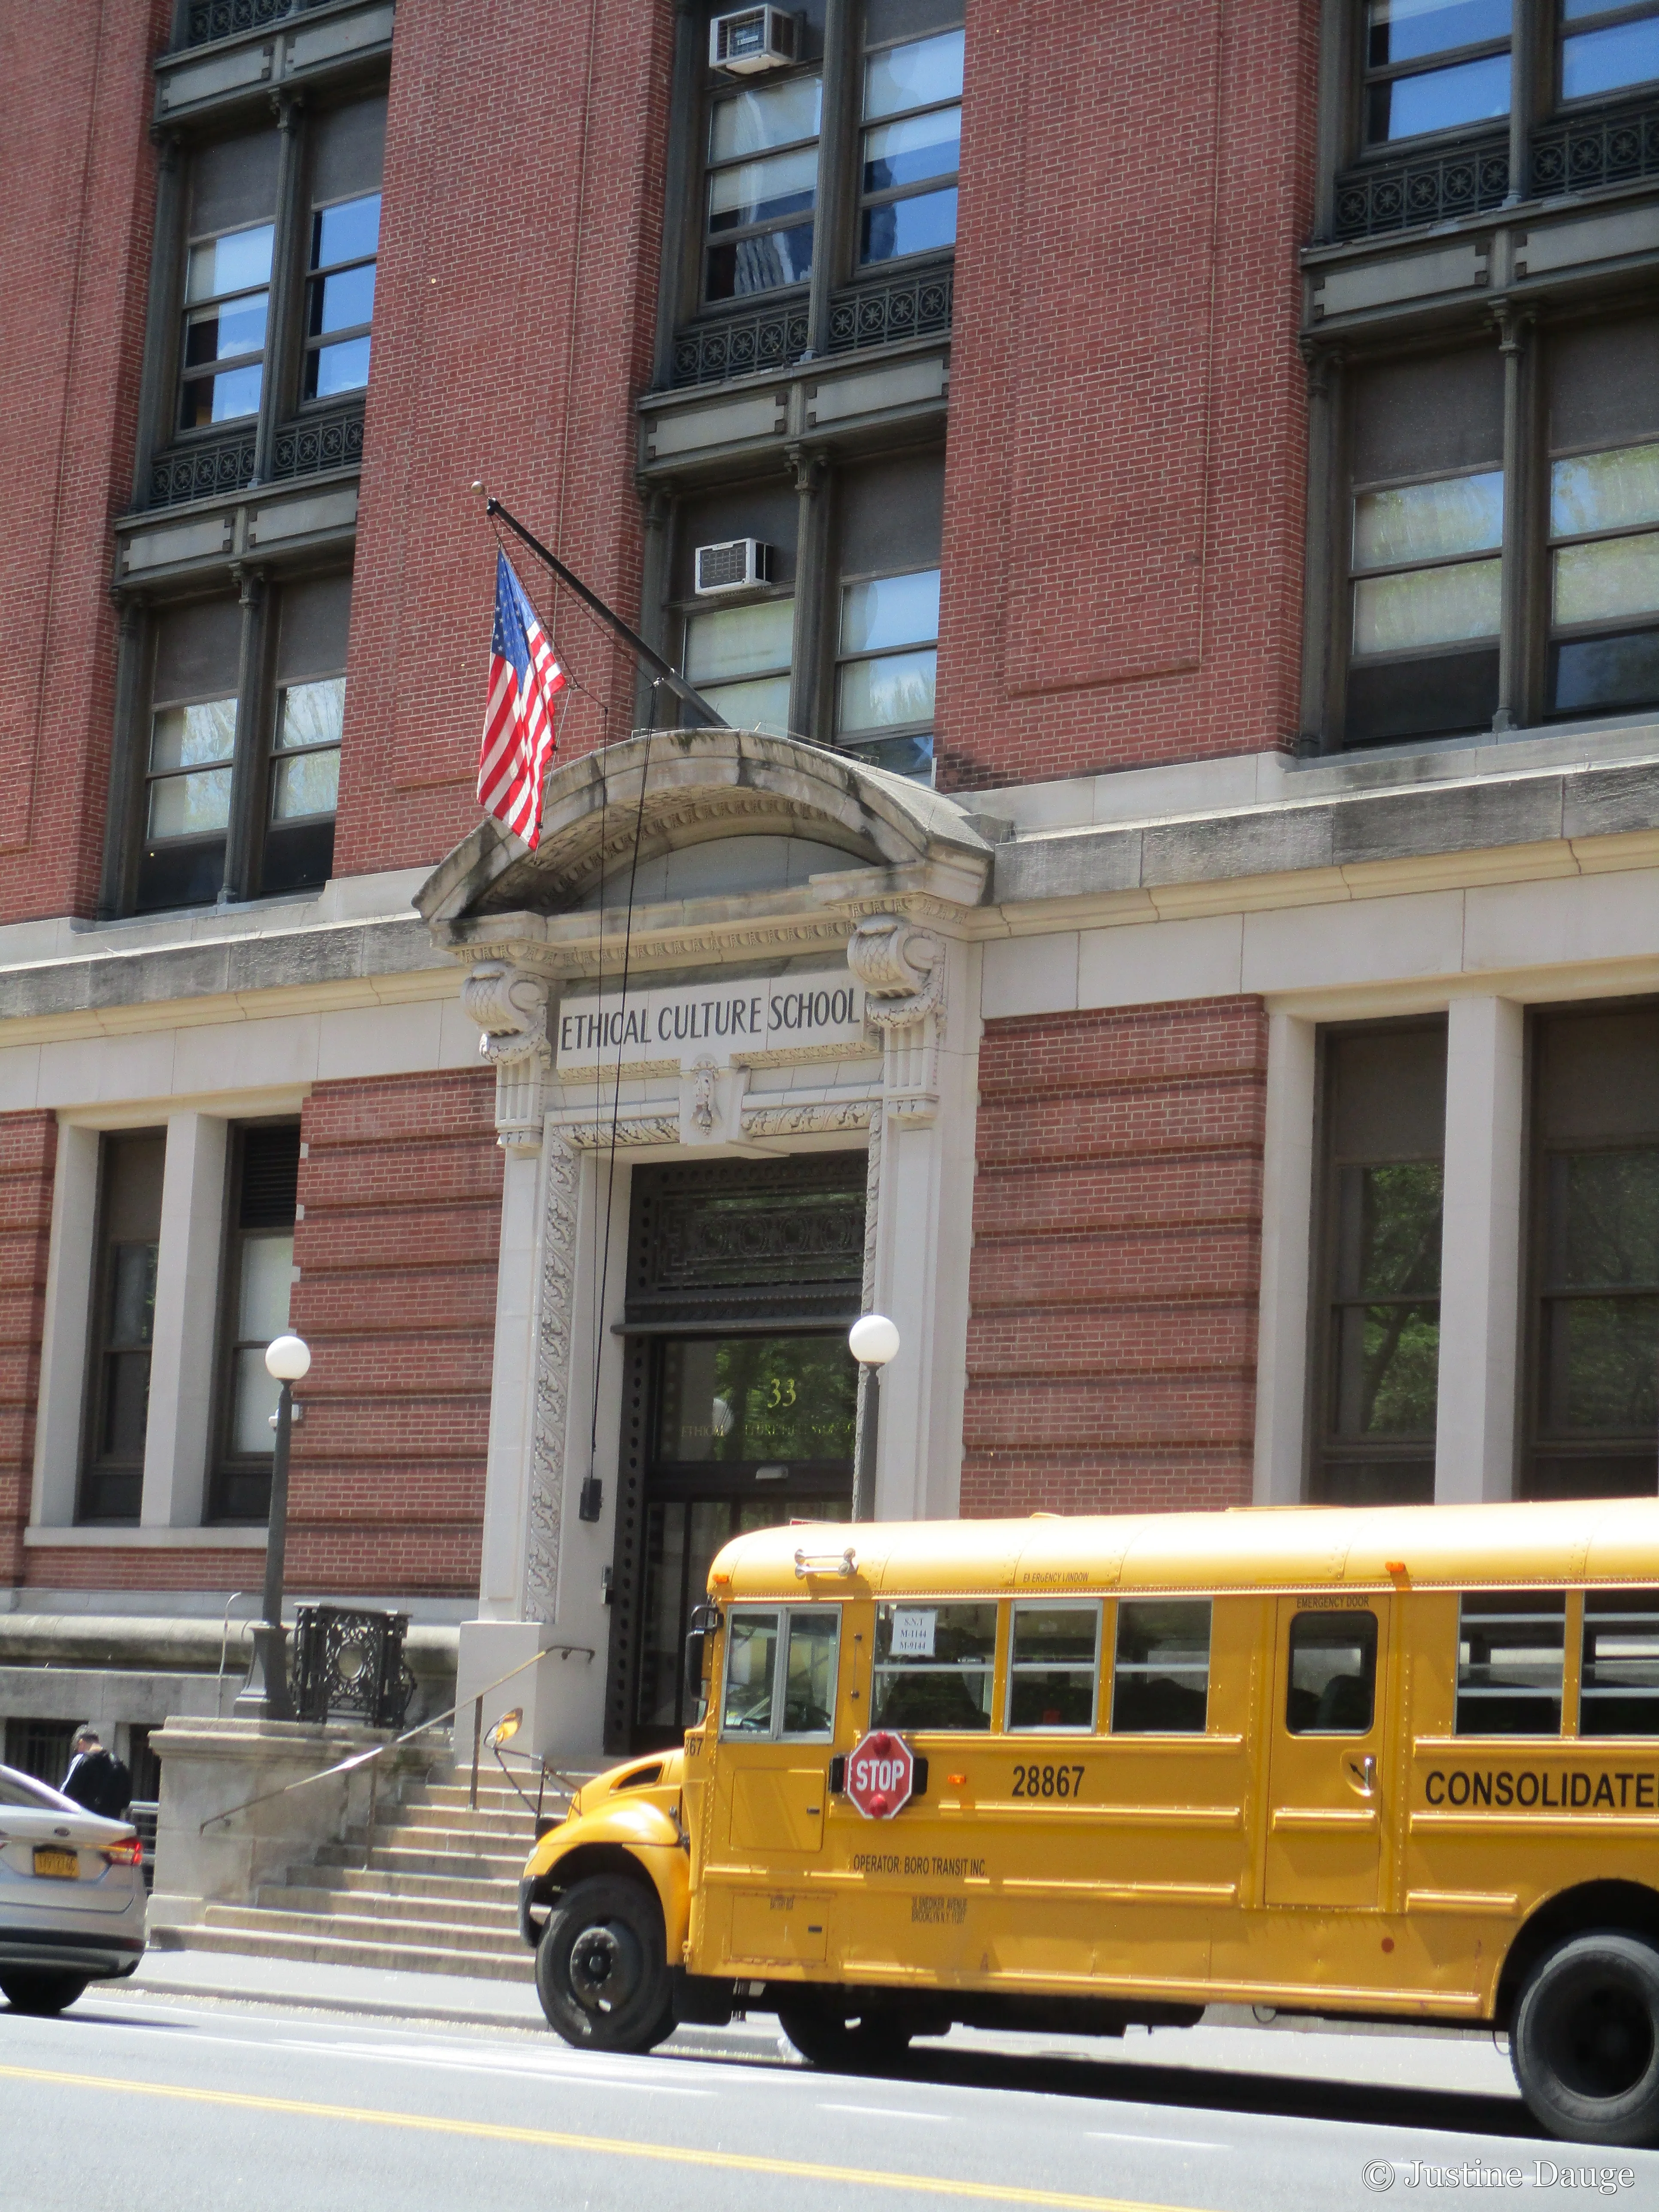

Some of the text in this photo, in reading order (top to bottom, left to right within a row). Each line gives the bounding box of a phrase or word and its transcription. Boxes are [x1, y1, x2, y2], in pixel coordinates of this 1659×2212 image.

[561, 988, 860, 1051] ETHICAL CULTURE SCHOOL
[767, 1378, 796, 1408] 33
[1297, 1595, 1369, 1608] EMERGENCY DOOR
[856, 1759, 904, 1792] STOP
[1012, 1765, 1085, 1797] 28867
[1425, 1771, 1659, 1808] CONSOLIDATE
[904, 1856, 929, 1875] BORO
[932, 1856, 968, 1876] TRANSIT
[970, 1858, 987, 1877] INC.
